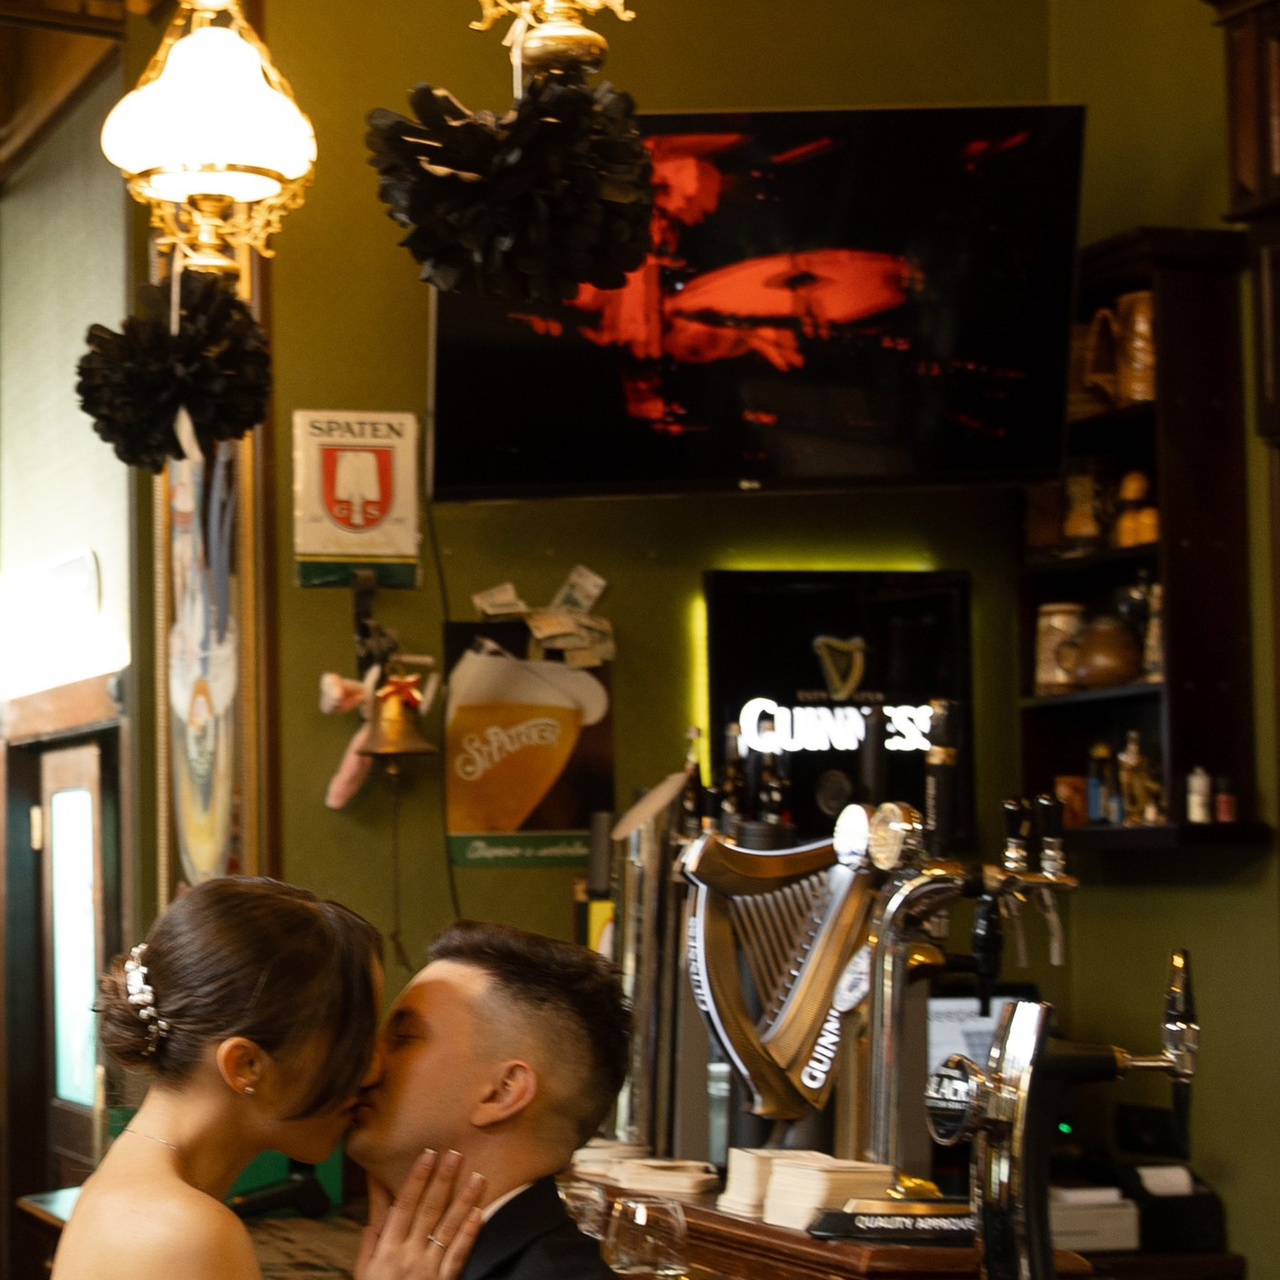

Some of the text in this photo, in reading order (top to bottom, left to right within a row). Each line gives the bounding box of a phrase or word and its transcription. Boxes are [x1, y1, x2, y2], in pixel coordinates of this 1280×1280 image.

[309, 420, 404, 438] SPATEN
[738, 697, 934, 753] GUINNSS
[800, 1008, 841, 1089] GUINN
[854, 1215, 976, 1231] QUALITY APPROVE
